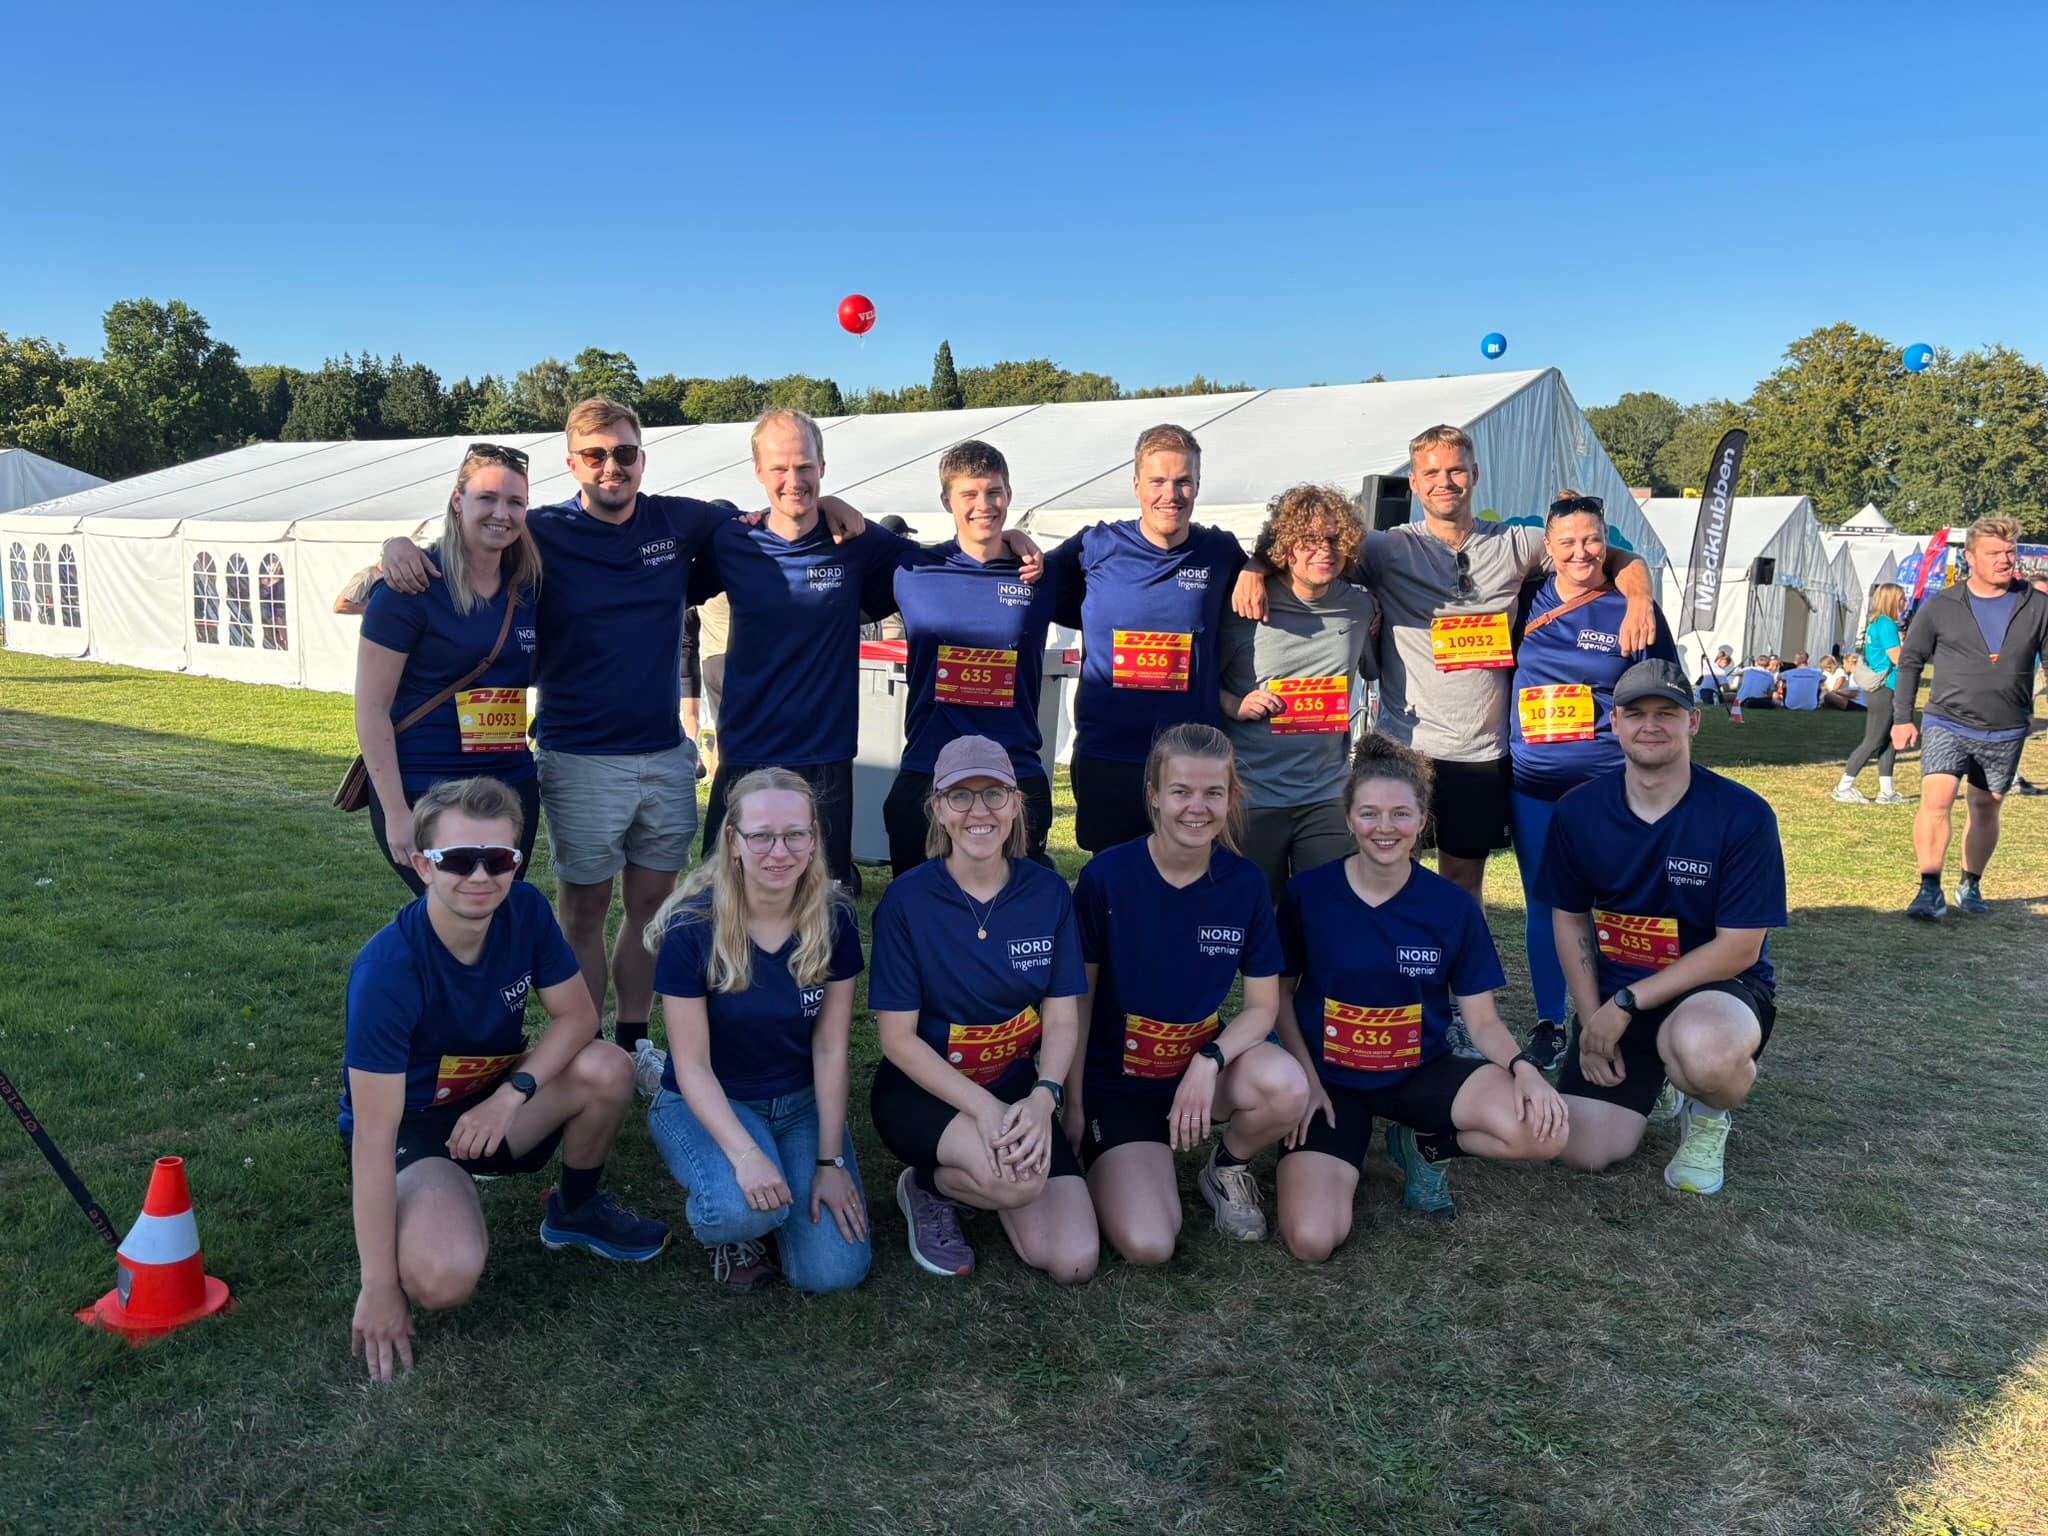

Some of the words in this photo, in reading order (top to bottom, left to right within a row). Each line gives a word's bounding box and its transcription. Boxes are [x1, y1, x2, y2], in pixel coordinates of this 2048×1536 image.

[1694, 448, 1736, 611] Madklubben
[642, 540, 674, 555] NORD
[809, 568, 842, 579] NORD
[1178, 568, 1208, 580] NORD
[1000, 584, 1031, 597] NORD
[1439, 615, 1498, 631] DHL
[1123, 632, 1182, 647] DHL
[1448, 634, 1495, 649] 10932
[1580, 631, 1614, 644] NORD
[946, 647, 1007, 664] DHL
[1136, 652, 1168, 668] 636
[961, 667, 992, 683] 635
[1279, 677, 1338, 693] DHL
[468, 689, 521, 704] DHL
[1525, 685, 1583, 702] DHL
[1293, 697, 1324, 712] 636
[478, 712, 517, 727] 10933
[1530, 705, 1577, 721] 10932
[1667, 859, 1708, 875] NORD
[1667, 872, 1707, 886] Ingeniør
[1600, 910, 1665, 933] DHL
[1200, 928, 1241, 942] NORD
[1619, 932, 1652, 951] 635
[1010, 940, 1052, 955] NORD
[1200, 943, 1240, 956] Ingeniør
[1012, 956, 1052, 971] Ingeniør
[1399, 949, 1438, 963] NORD
[1399, 963, 1437, 977] Ingeniør
[504, 975, 532, 1002] NOR
[803, 988, 824, 1005] NO
[1335, 1003, 1410, 1024] DHL
[961, 1011, 1034, 1041] DHL
[1136, 1017, 1210, 1038] DHL
[1351, 1029, 1392, 1046] 636
[979, 1041, 1017, 1062] 635
[1152, 1042, 1192, 1057] 636
